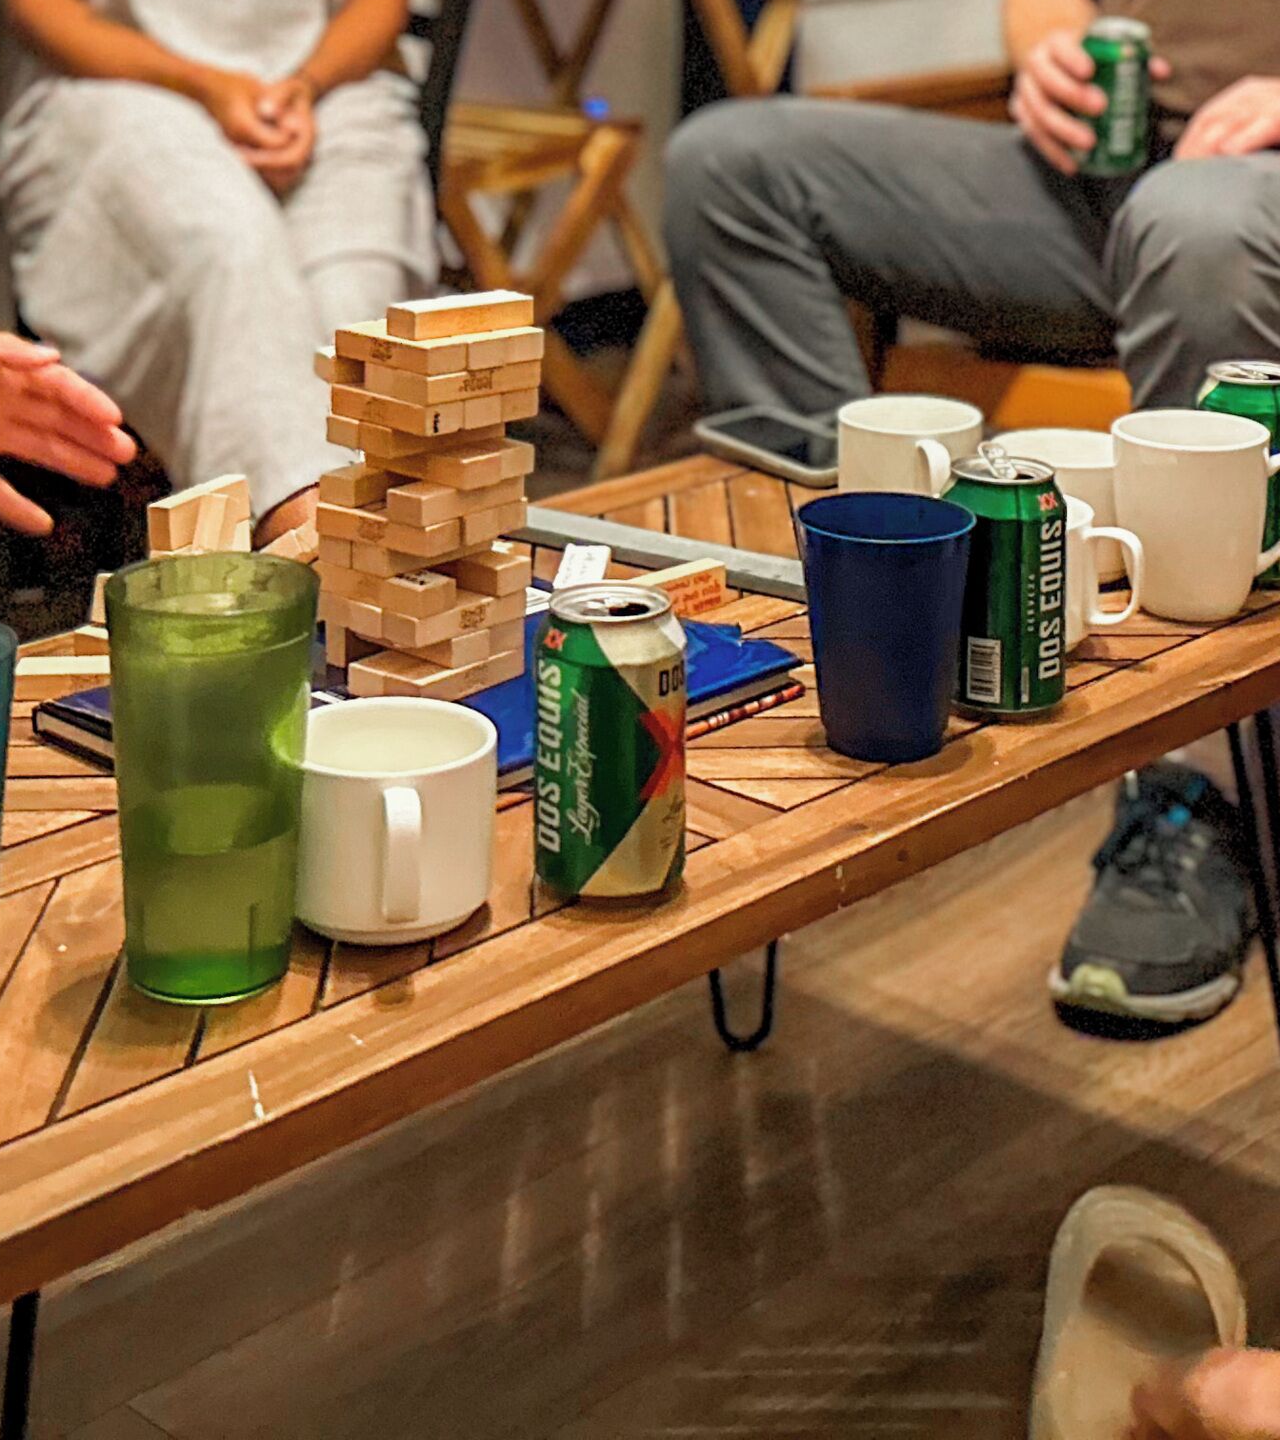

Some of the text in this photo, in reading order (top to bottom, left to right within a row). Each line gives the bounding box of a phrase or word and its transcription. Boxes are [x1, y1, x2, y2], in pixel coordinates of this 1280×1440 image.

[1038, 519, 1062, 680] DOS EQUIS
[537, 659, 562, 853] DOS EQUIS
[566, 687, 600, 846] Lager Especial
